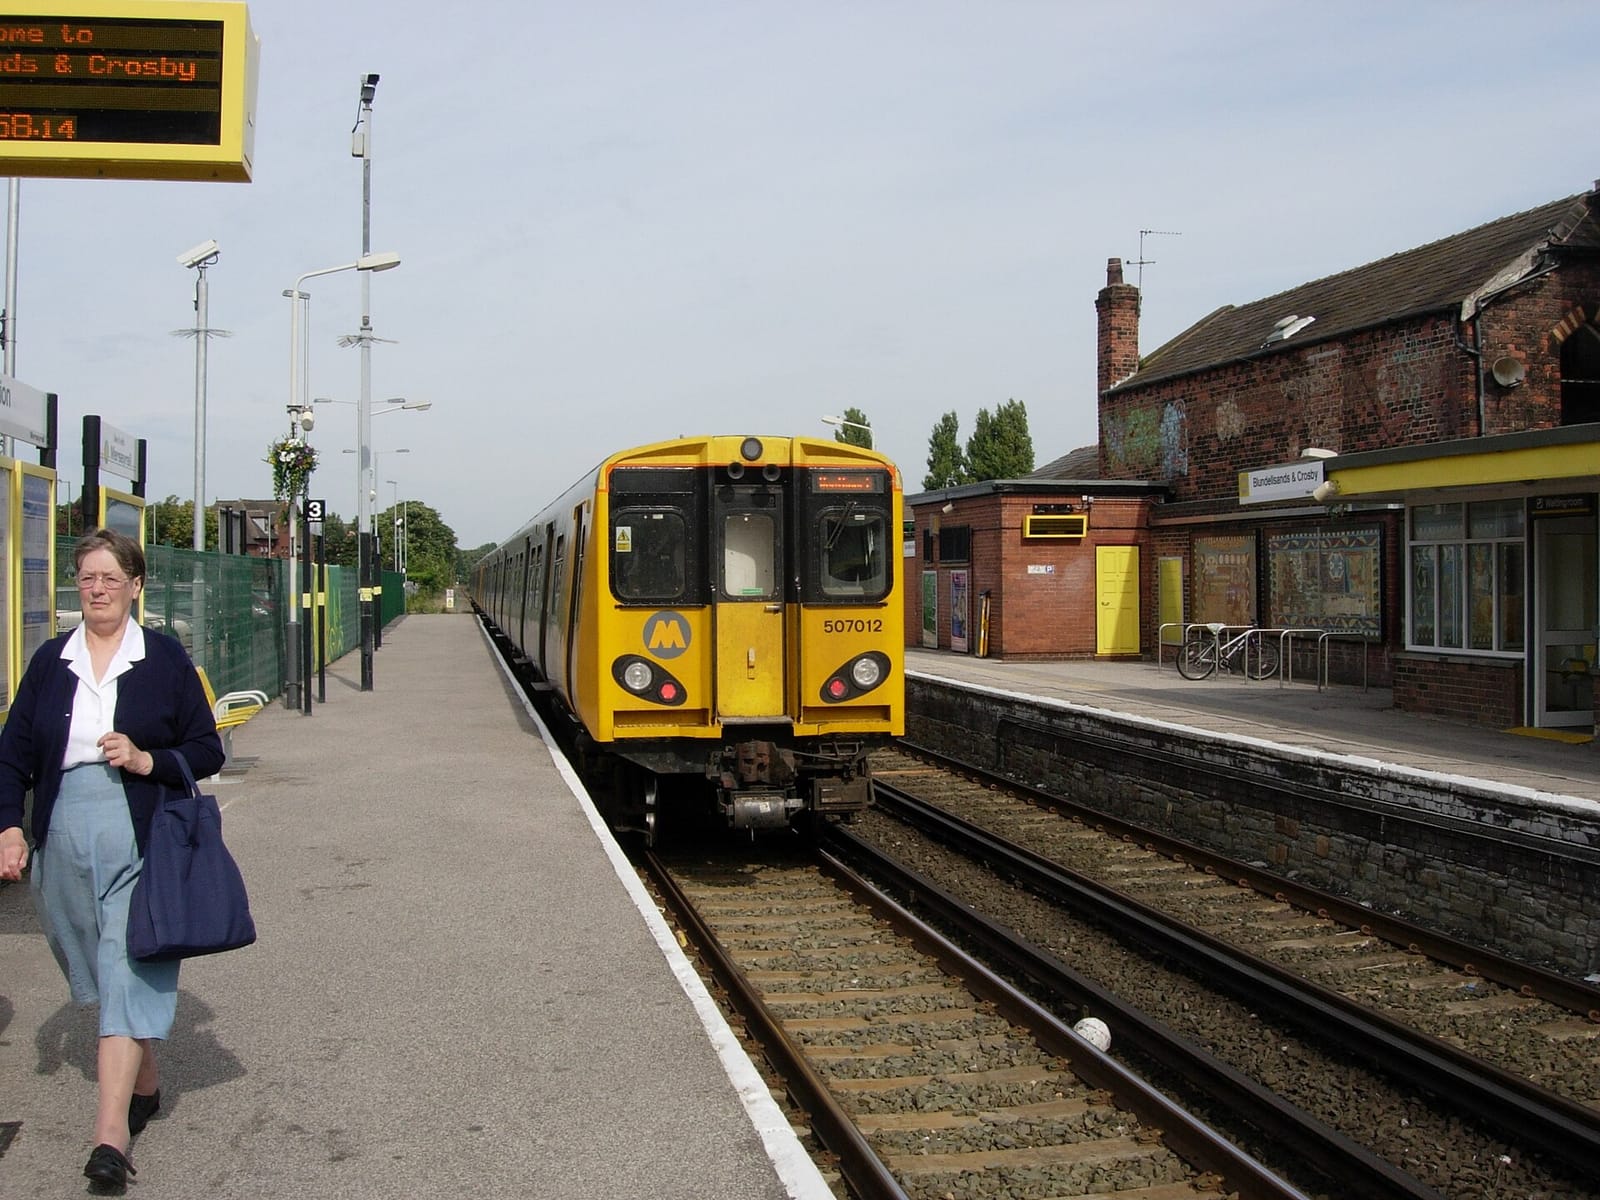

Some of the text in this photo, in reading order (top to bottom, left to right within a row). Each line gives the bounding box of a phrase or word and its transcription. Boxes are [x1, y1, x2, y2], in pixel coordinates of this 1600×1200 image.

[61, 24, 93, 43] to
[0, 53, 196, 81] ds & Crosby
[1252, 469, 1318, 488] Blundellsands & Crosby
[308, 501, 322, 518] 3
[823, 619, 883, 634] 507012
